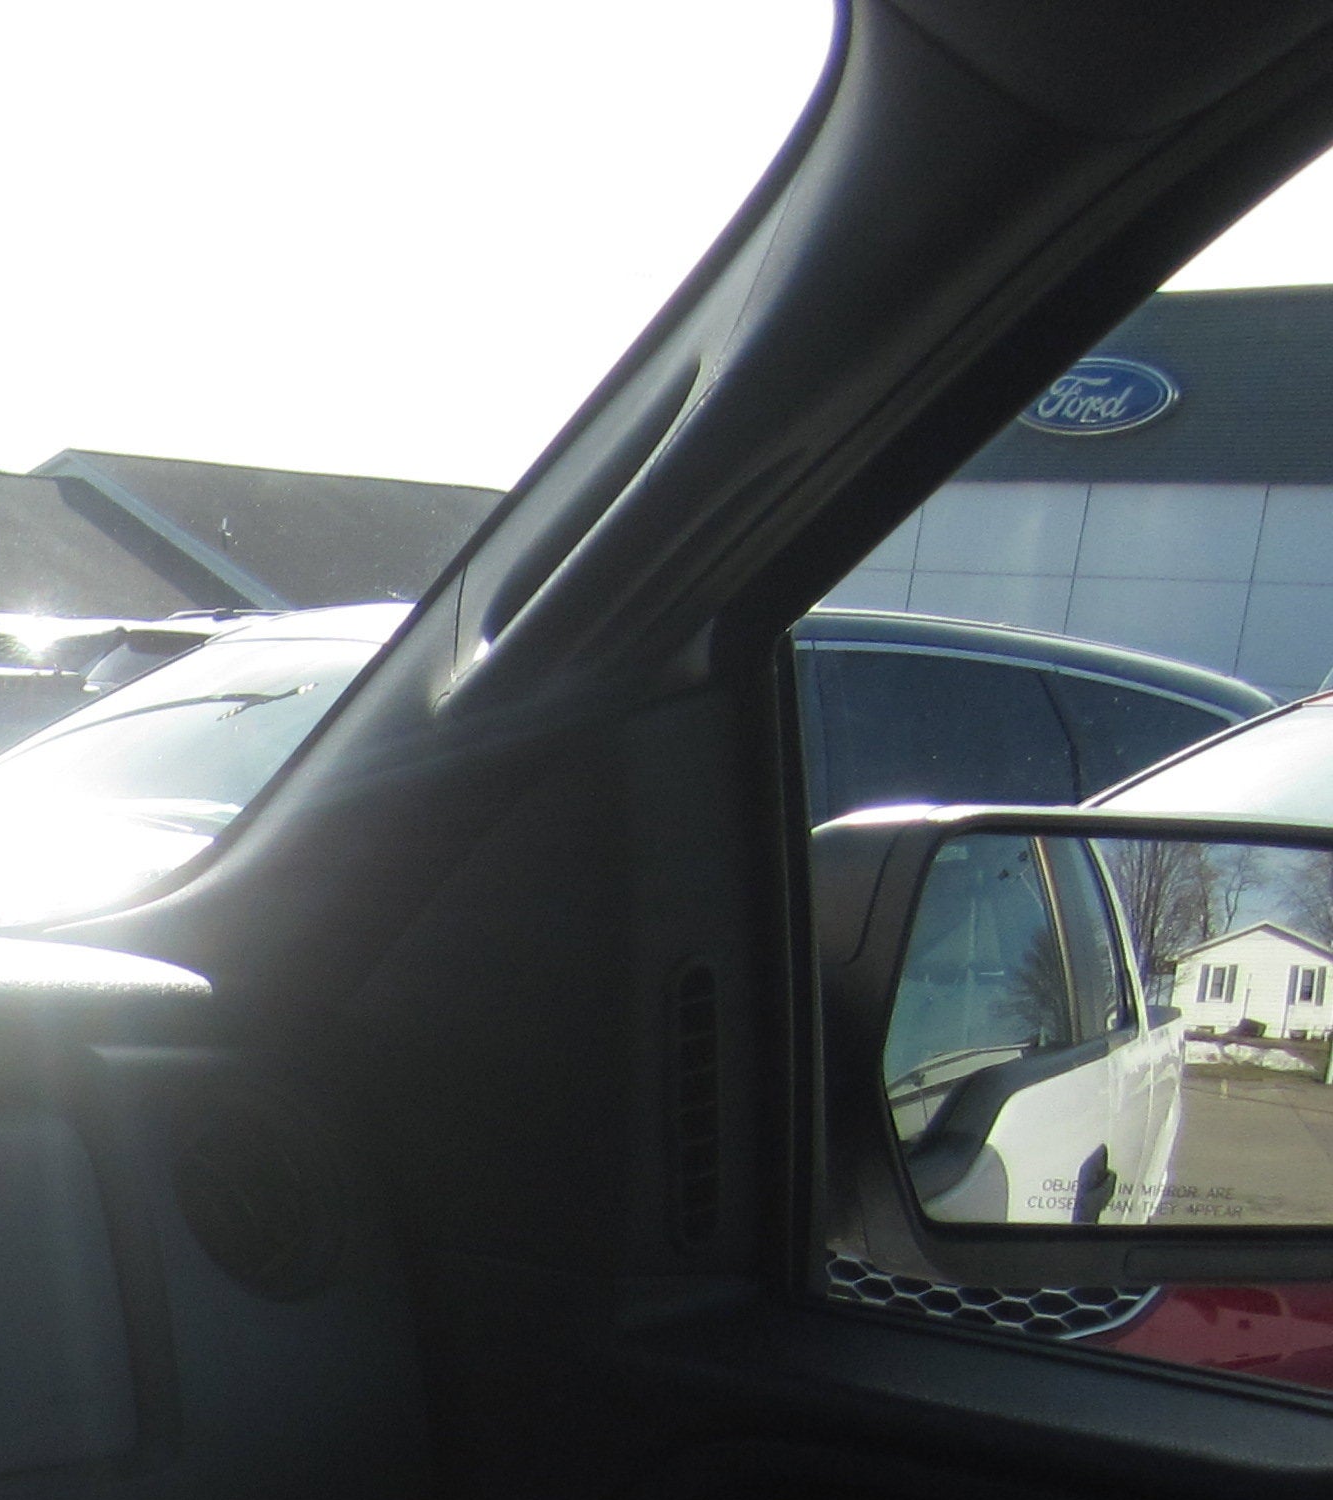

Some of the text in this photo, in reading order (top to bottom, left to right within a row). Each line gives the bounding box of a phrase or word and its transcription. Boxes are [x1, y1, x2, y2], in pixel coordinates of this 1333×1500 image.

[1037, 376, 1133, 423] Ford
[1119, 1183, 1133, 1195] IN
[1207, 1186, 1235, 1200] ARE
[1027, 1195, 1078, 1210] CLOSE
[1186, 1203, 1244, 1217] APPEAR
